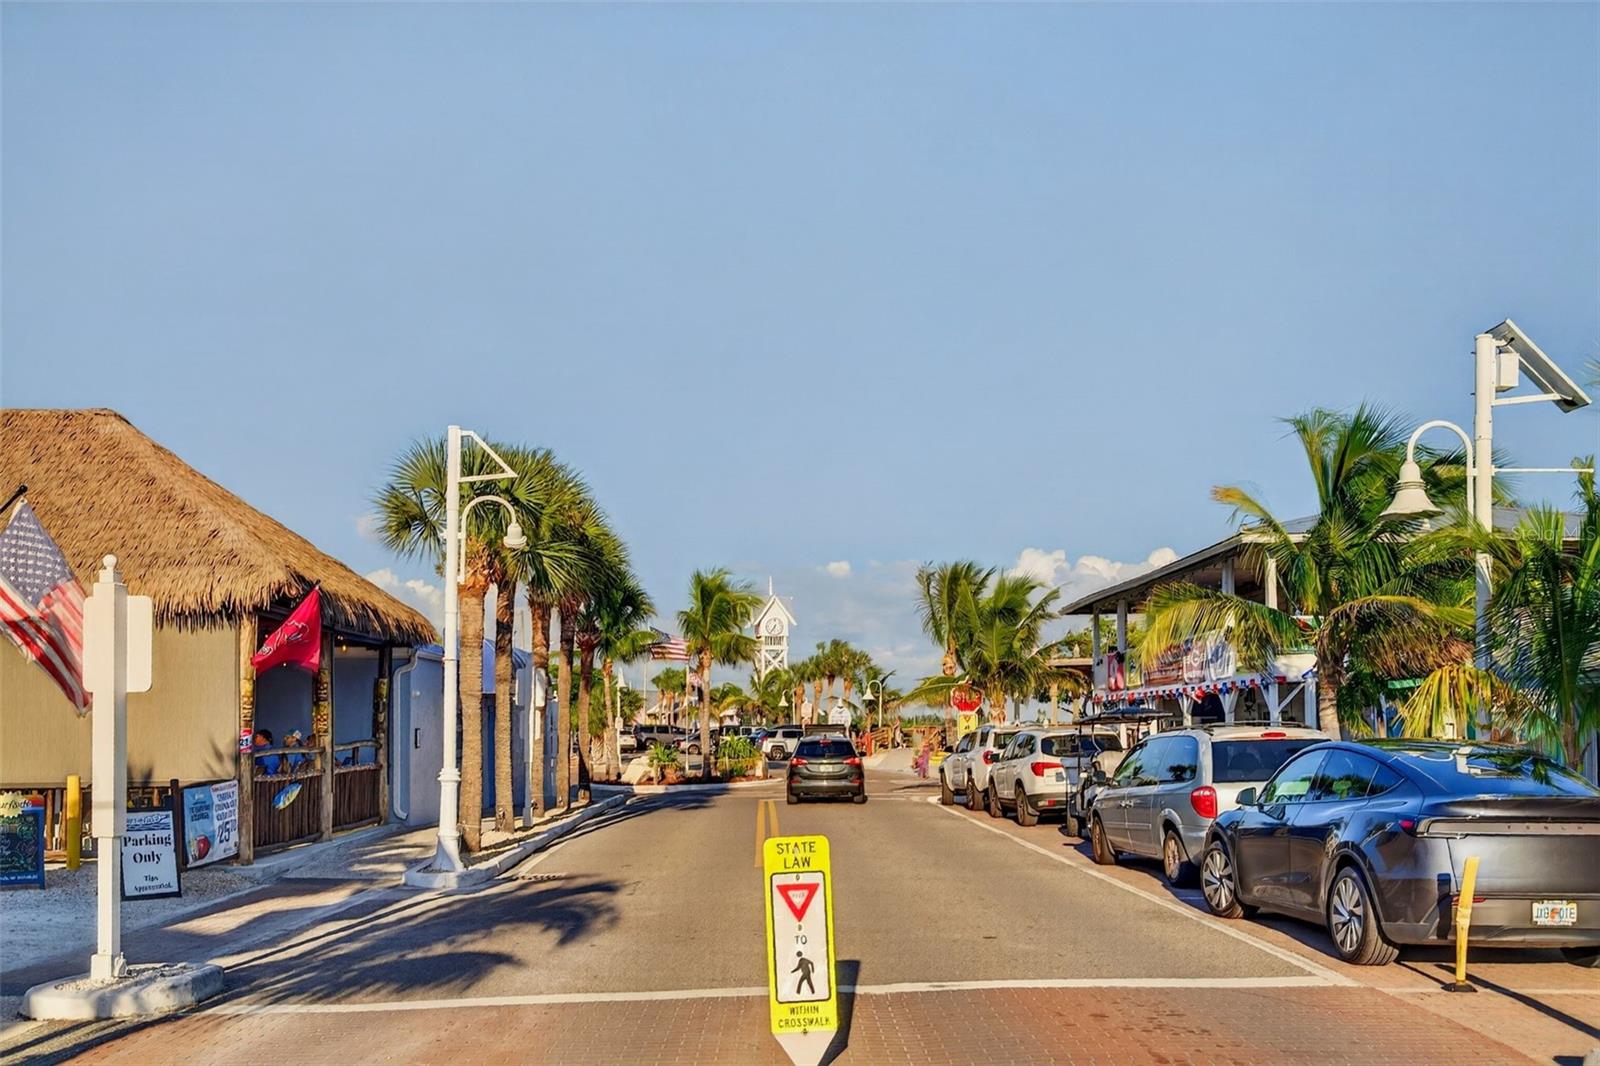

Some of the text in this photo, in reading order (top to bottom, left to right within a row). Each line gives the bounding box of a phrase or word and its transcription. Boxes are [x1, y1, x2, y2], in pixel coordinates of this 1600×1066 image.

[123, 833, 172, 848] Parking
[776, 841, 817, 855] STATE
[132, 851, 163, 865] Only
[783, 856, 812, 869] LAW
[794, 934, 808, 945] TO
[789, 1005, 820, 1016] WITHIN
[778, 1016, 831, 1029] CROSSWALK
